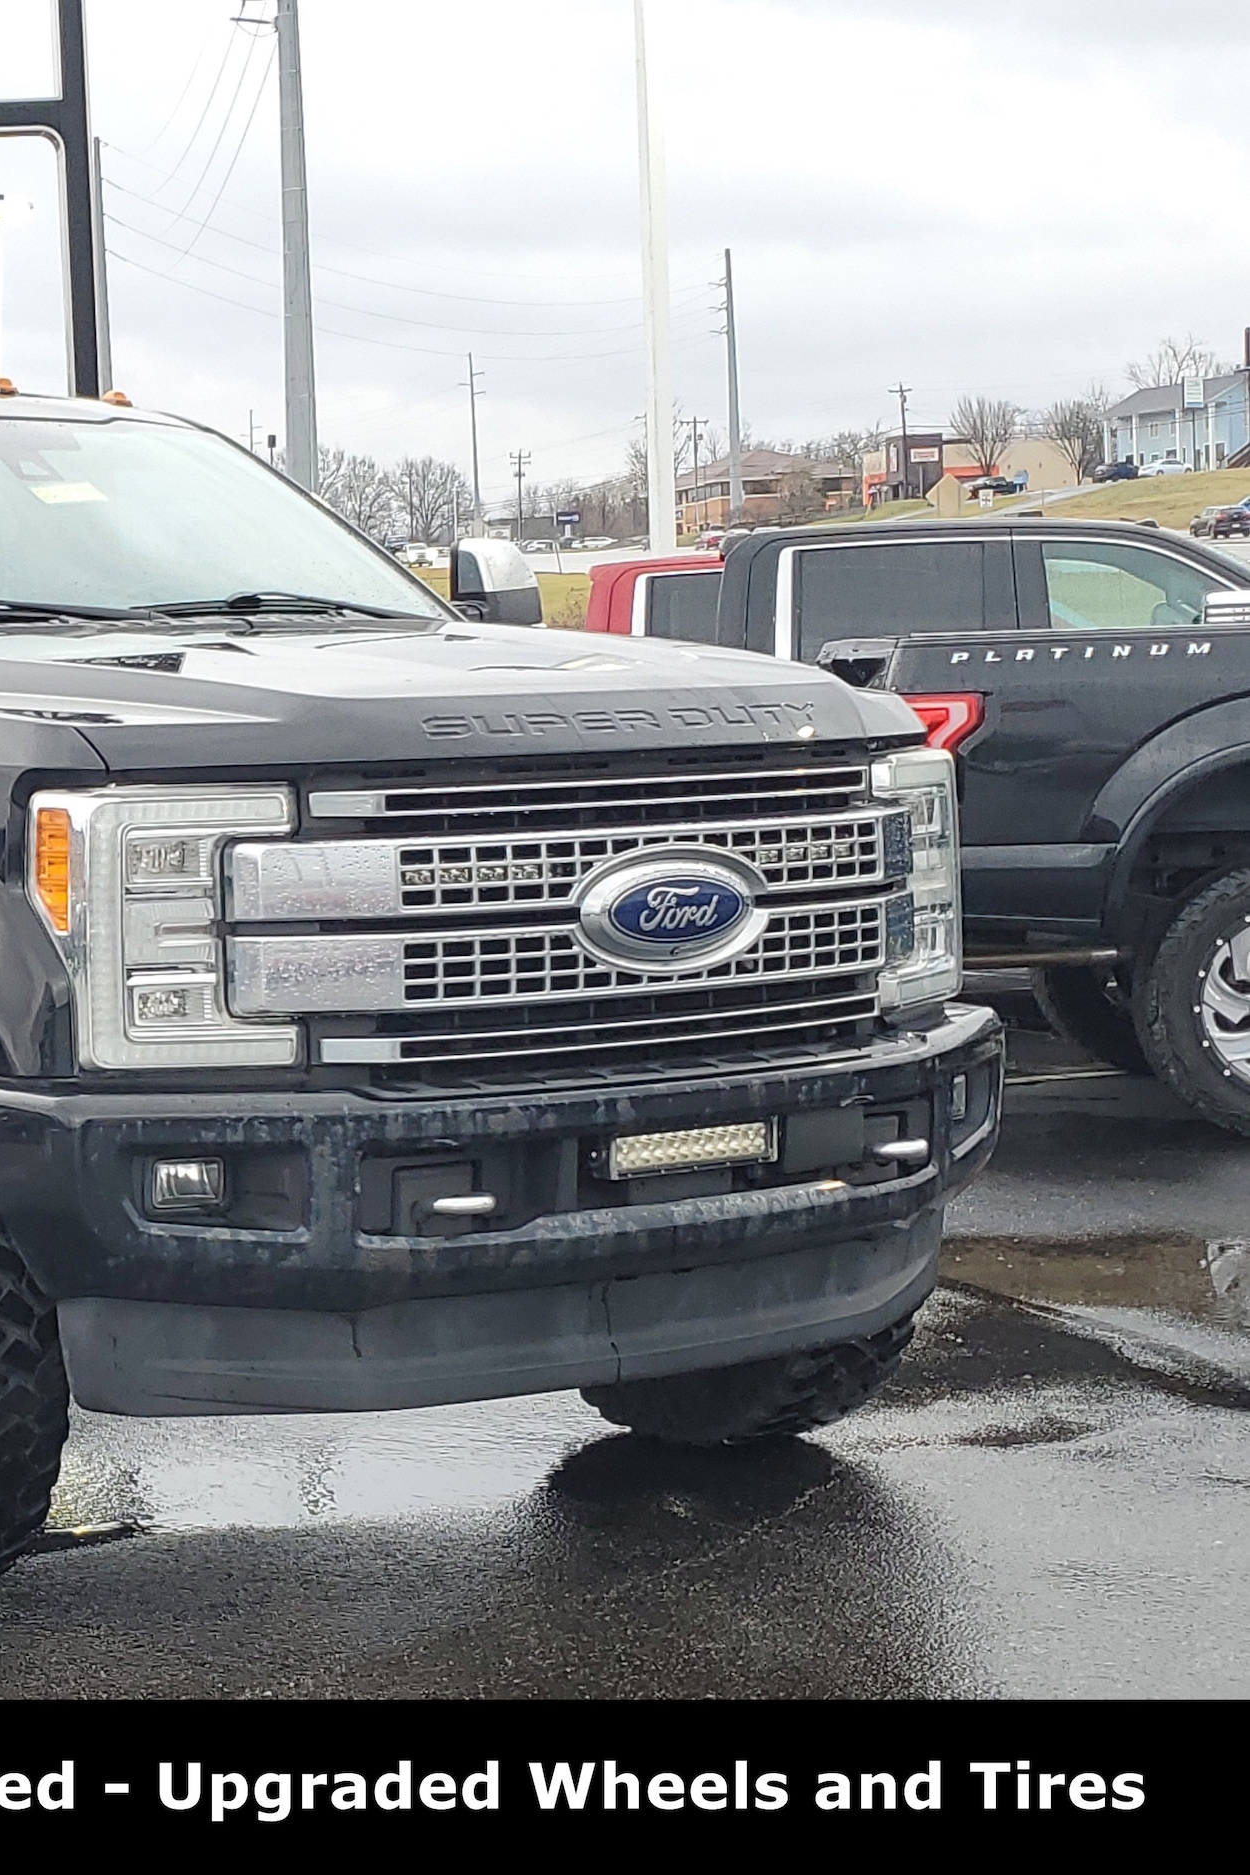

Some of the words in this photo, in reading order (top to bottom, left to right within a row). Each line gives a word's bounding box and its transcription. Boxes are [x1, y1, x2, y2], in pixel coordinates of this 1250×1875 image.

[951, 642, 1212, 665] PLATINUM
[421, 707, 662, 740] SUPER
[667, 701, 815, 731] DUTY
[639, 885, 719, 932] Ford
